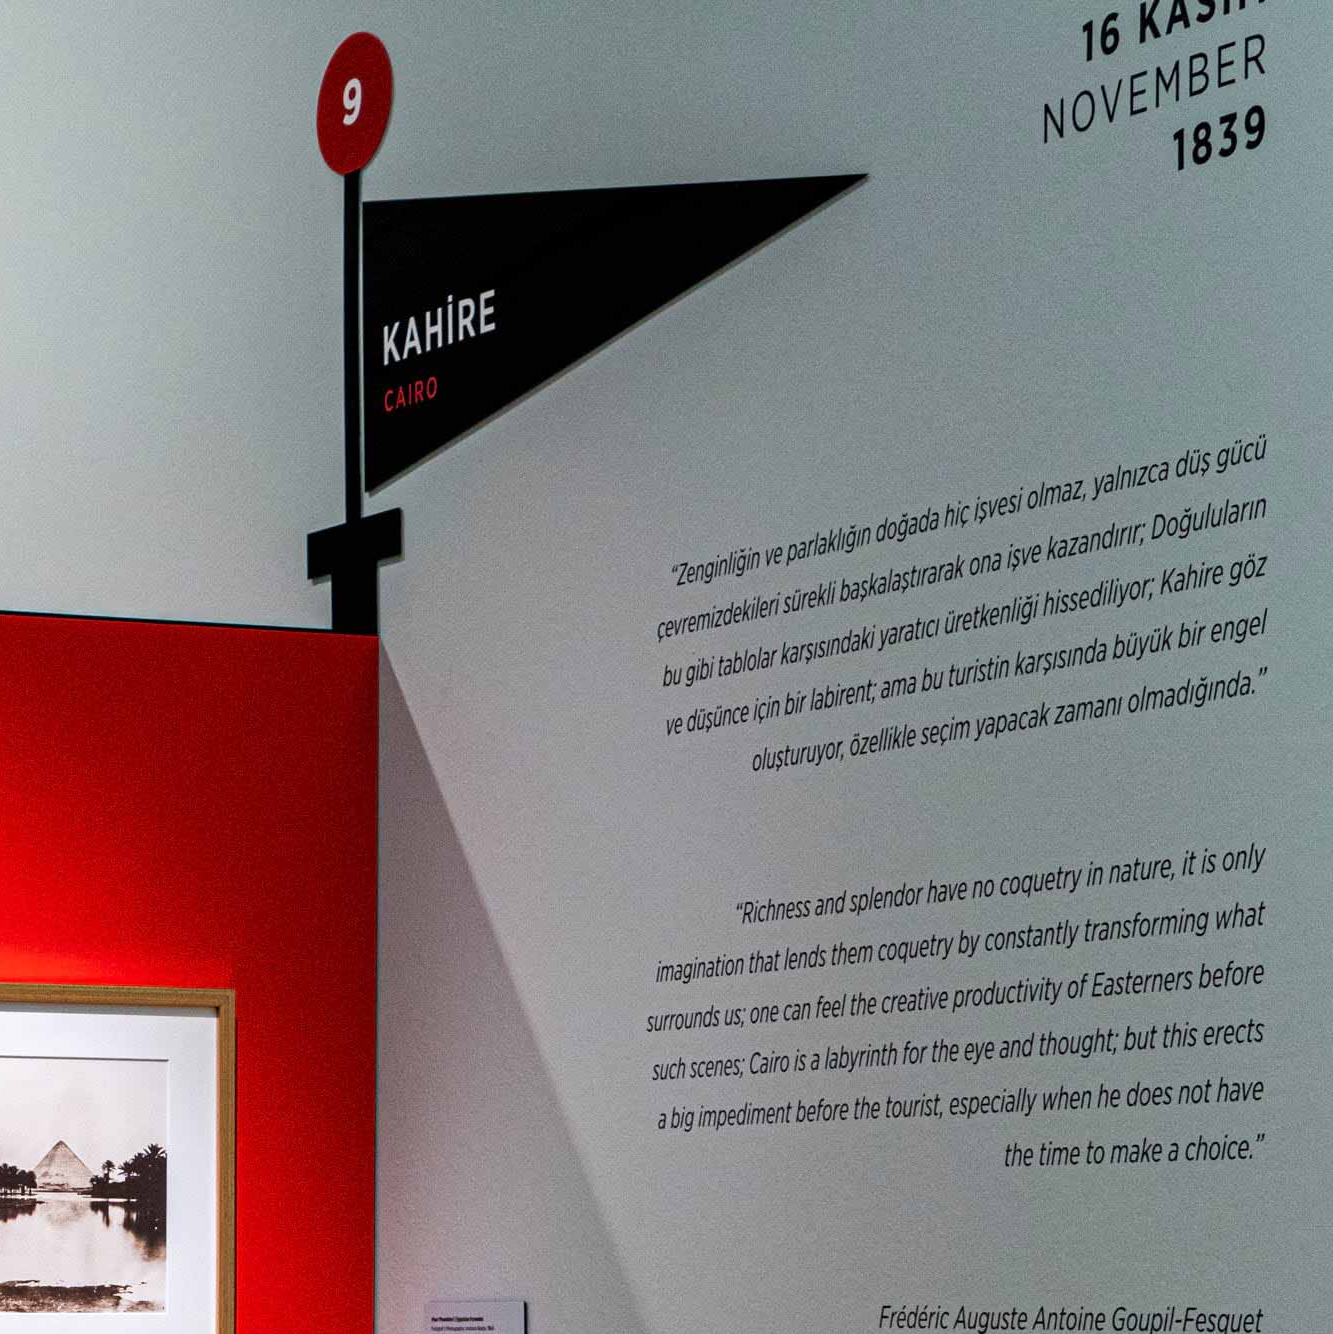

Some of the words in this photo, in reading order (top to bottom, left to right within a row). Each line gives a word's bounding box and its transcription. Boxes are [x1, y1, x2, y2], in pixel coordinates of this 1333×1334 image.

[1082, 12, 1120, 61] 16
[1139, 0, 1267, 44] KAS
[342, 78, 363, 127] 9
[1042, 33, 1267, 144] NOVEMBER
[1173, 105, 1267, 170] 1839
[383, 288, 497, 366] KAHİRE
[383, 376, 438, 412] CAIRO
[766, 546, 783, 566] ve
[786, 525, 871, 566] parlaklığın
[876, 507, 939, 542] doğada
[944, 501, 970, 528] hiç
[974, 487, 1023, 524] işvesi
[1027, 480, 1086, 510] olmaz,
[1092, 461, 1169, 501] yalnızca
[1176, 449, 1211, 478] düş
[1216, 434, 1267, 474] gücü
[657, 592, 781, 643] çevremizdekileri
[783, 581, 836, 614] sürekli
[839, 555, 965, 602] başkalaştırarak
[969, 552, 1002, 576] ona
[1007, 544, 1042, 572] işve
[1151, 498, 1267, 540] Doğuluların
[663, 665, 682, 687] bu
[685, 656, 715, 687] gibi
[718, 647, 778, 677] tablolar
[780, 625, 876, 665] karşısındaki
[878, 618, 940, 652] yaratıcı
[944, 593, 1040, 635] üretkenliği
[1160, 562, 1224, 595] Kahire
[1229, 553, 1268, 587] göz
[666, 717, 683, 736] ve
[687, 705, 749, 733] düşünce
[753, 696, 780, 724] için
[784, 691, 807, 716] bir
[881, 676, 917, 699] ama
[921, 668, 944, 692] bu
[949, 655, 1010, 687] turistin
[1014, 637, 1107, 676] karşısında
[1112, 625, 1173, 661] büyük
[1178, 620, 1206, 648] bir
[1211, 608, 1268, 644] engel
[752, 741, 844, 772] oluşturuyor,
[850, 724, 916, 756] özellikle
[920, 716, 970, 746] seçim
[974, 702, 1050, 742] yapacak
[1054, 696, 1123, 725] zamanı
[815, 890, 847, 916] and
[849, 883, 924, 916] splendor
[927, 880, 968, 904] have
[972, 879, 995, 899] no
[1000, 866, 1082, 898] coquetry
[1086, 861, 1103, 887] in
[1109, 858, 1175, 884] nature,
[1182, 850, 1197, 876] it
[1201, 848, 1217, 874] is
[1222, 842, 1266, 874] only
[656, 954, 744, 984] imagination
[749, 950, 781, 974] that
[784, 944, 827, 970] lends
[831, 942, 873, 966] them
[878, 934, 954, 964] coquetry
[958, 930, 980, 958] by
[985, 919, 1079, 951] constantly
[1084, 908, 1209, 942] transforming
[1216, 901, 1266, 930] what
[646, 1005, 720, 1032] surrounds
[750, 1005, 779, 1024] one
[783, 1002, 811, 1021] can
[816, 993, 847, 1018] feel
[850, 992, 877, 1016] the
[881, 986, 948, 1014] creative
[952, 977, 1063, 1013] productivity
[1067, 973, 1089, 999] of
[1091, 970, 1193, 997] Easterners
[1198, 960, 1265, 989] before
[652, 1057, 686, 1081] such
[750, 1050, 790, 1075] Cairo
[794, 1049, 807, 1071] is
[810, 1053, 820, 1071] a
[825, 1042, 898, 1073] labyrinth
[902, 1040, 928, 1064] for
[932, 1039, 959, 1063] the
[964, 1041, 995, 1065] eye
[999, 1032, 1035, 1059] and
[1123, 1025, 1158, 1051] but
[1163, 1022, 1198, 1048] this
[1203, 1019, 1265, 1046] erects
[658, 1113, 667, 1130] a
[670, 1106, 695, 1133] big
[698, 1102, 792, 1131] impediment
[796, 1098, 849, 1123] before
[854, 1096, 880, 1120] the
[886, 1093, 943, 1119] tourist,
[949, 1087, 1037, 1119] especially
[1043, 1085, 1092, 1111] when
[1097, 1083, 1121, 1108] he
[1126, 1081, 1173, 1107] does
[1178, 1079, 1212, 1104] not
[1216, 1077, 1264, 1102] have
[1005, 1142, 1034, 1167] the
[1039, 1141, 1080, 1166] time
[1086, 1141, 1105, 1164] to
[1110, 1137, 1162, 1164] make
[1168, 1142, 1179, 1162] a
[879, 1305, 950, 1329] Frédéric
[953, 1306, 1028, 1334] Auguste
[1032, 1306, 1106, 1331] Antoine
